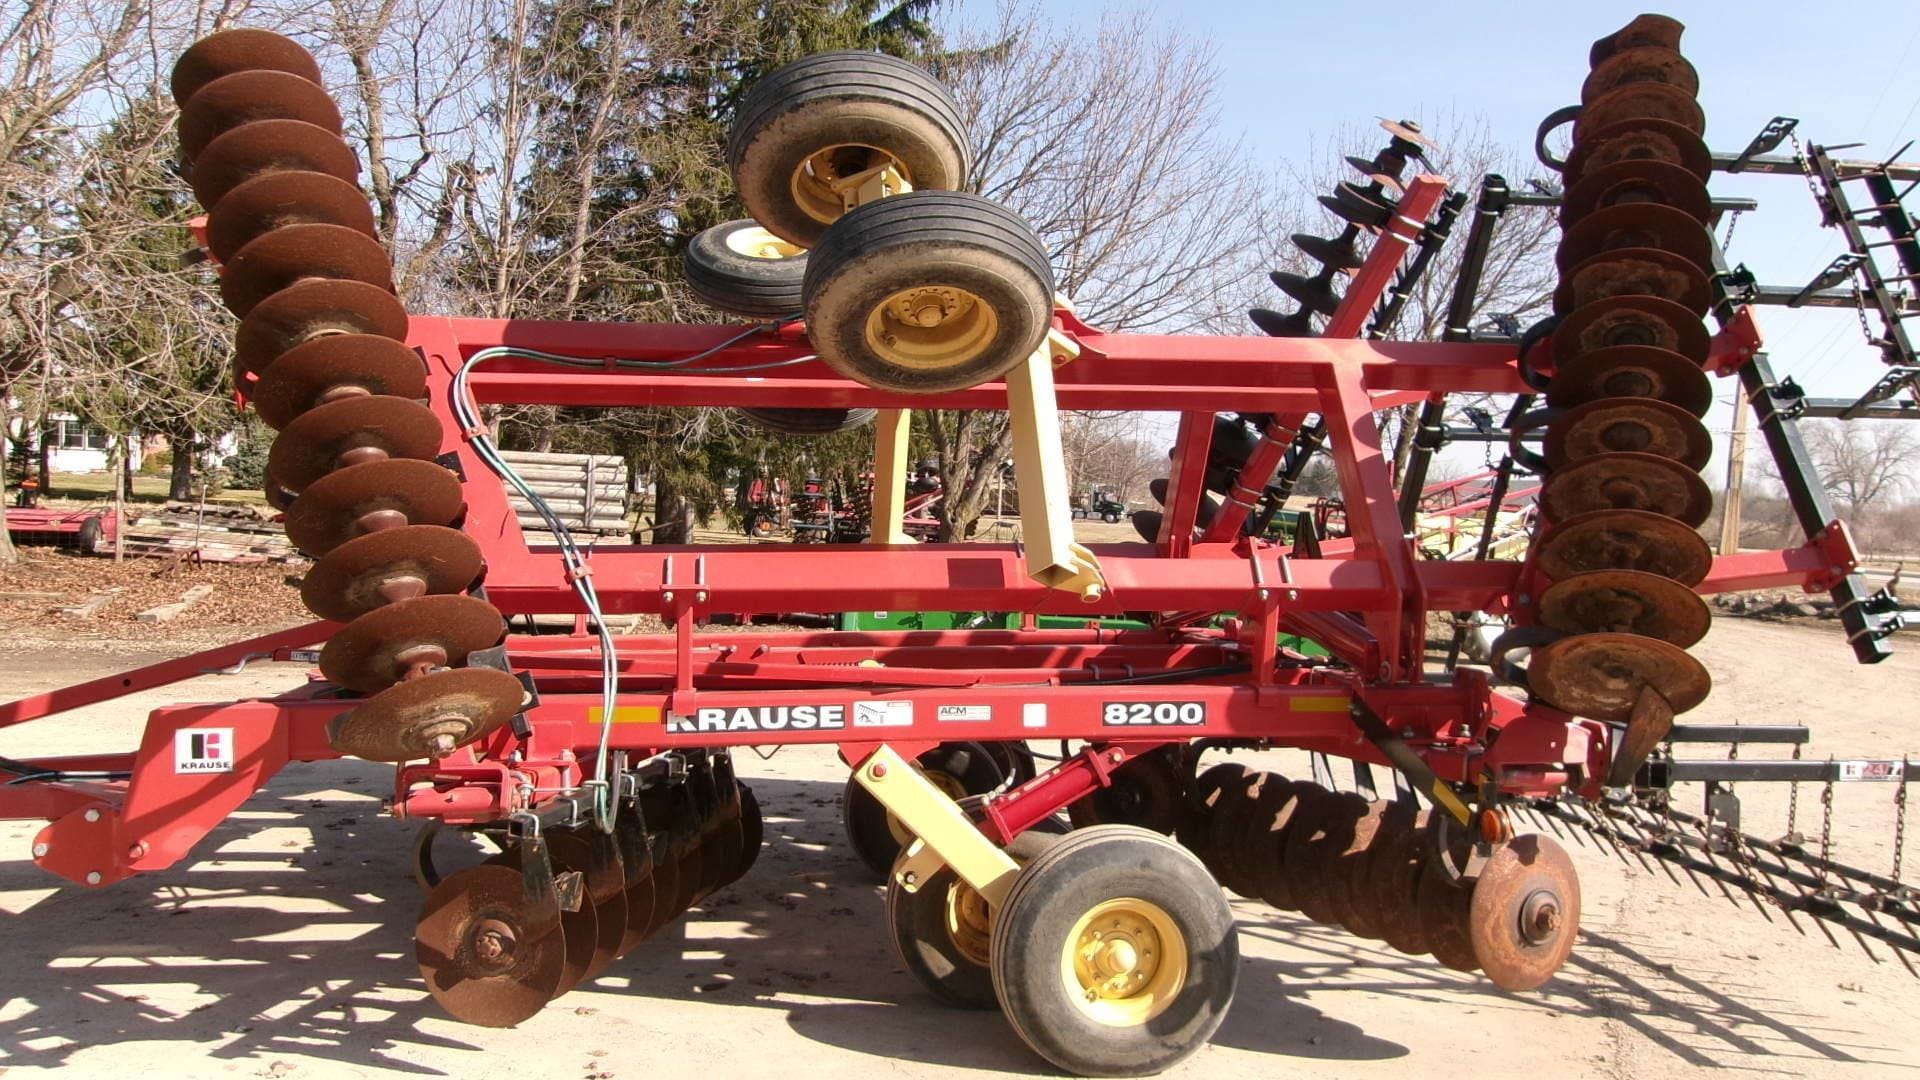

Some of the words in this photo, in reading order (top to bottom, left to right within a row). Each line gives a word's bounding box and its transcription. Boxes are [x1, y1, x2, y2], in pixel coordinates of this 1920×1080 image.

[667, 705, 845, 732] KRAUSE
[940, 707, 967, 716] ACM
[1104, 703, 1203, 725] 8200
[181, 761, 231, 770] KRAUSE
